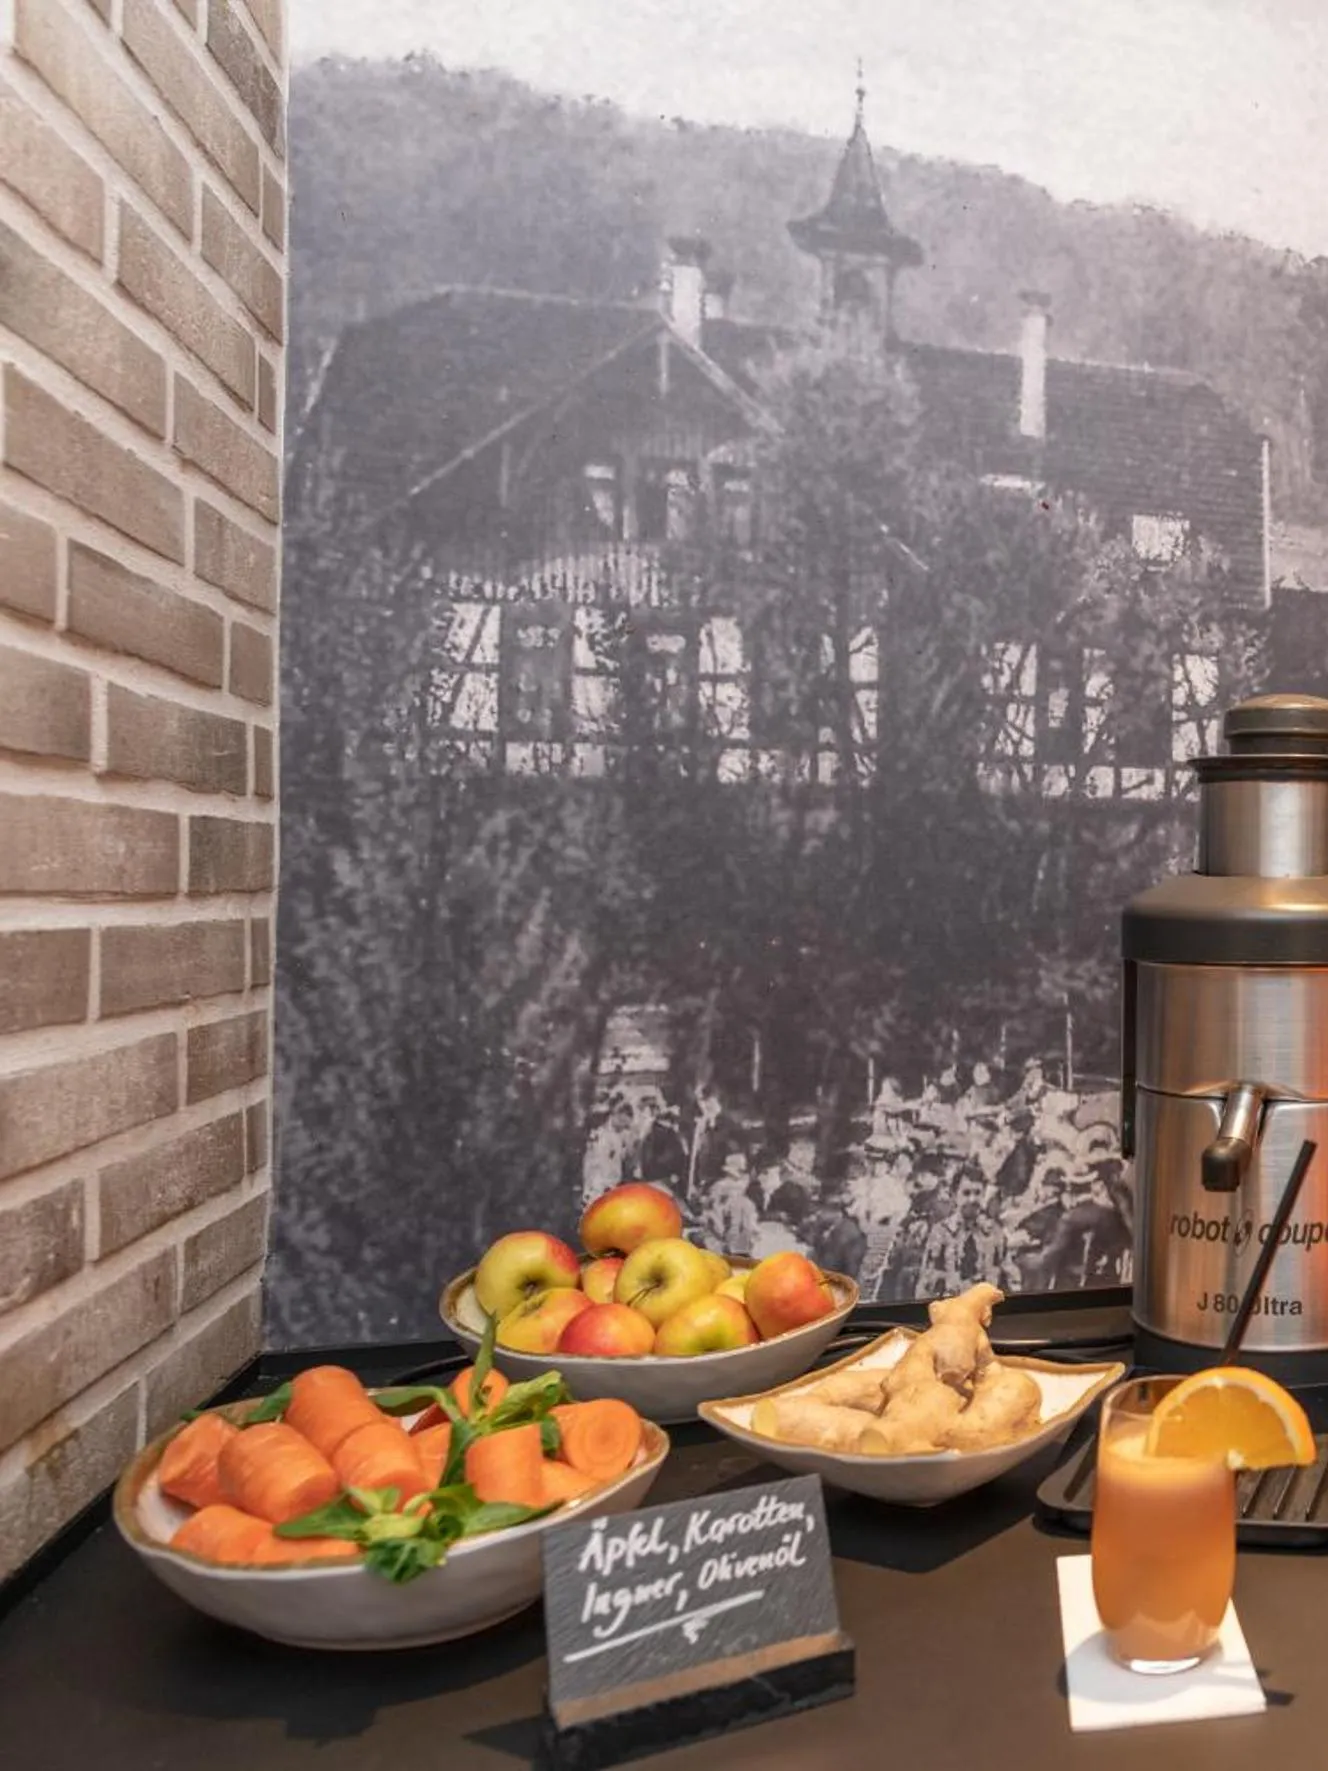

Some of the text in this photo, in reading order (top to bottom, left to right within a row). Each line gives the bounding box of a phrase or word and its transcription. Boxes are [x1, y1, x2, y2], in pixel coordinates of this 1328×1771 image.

[1170, 1211, 1231, 1244] robot
[1196, 1292, 1208, 1312] J
[1213, 1294, 1239, 1315] 80
[577, 1495, 815, 1577] Äpfel, Karotten,
[697, 1531, 808, 1590] Olivenöl
